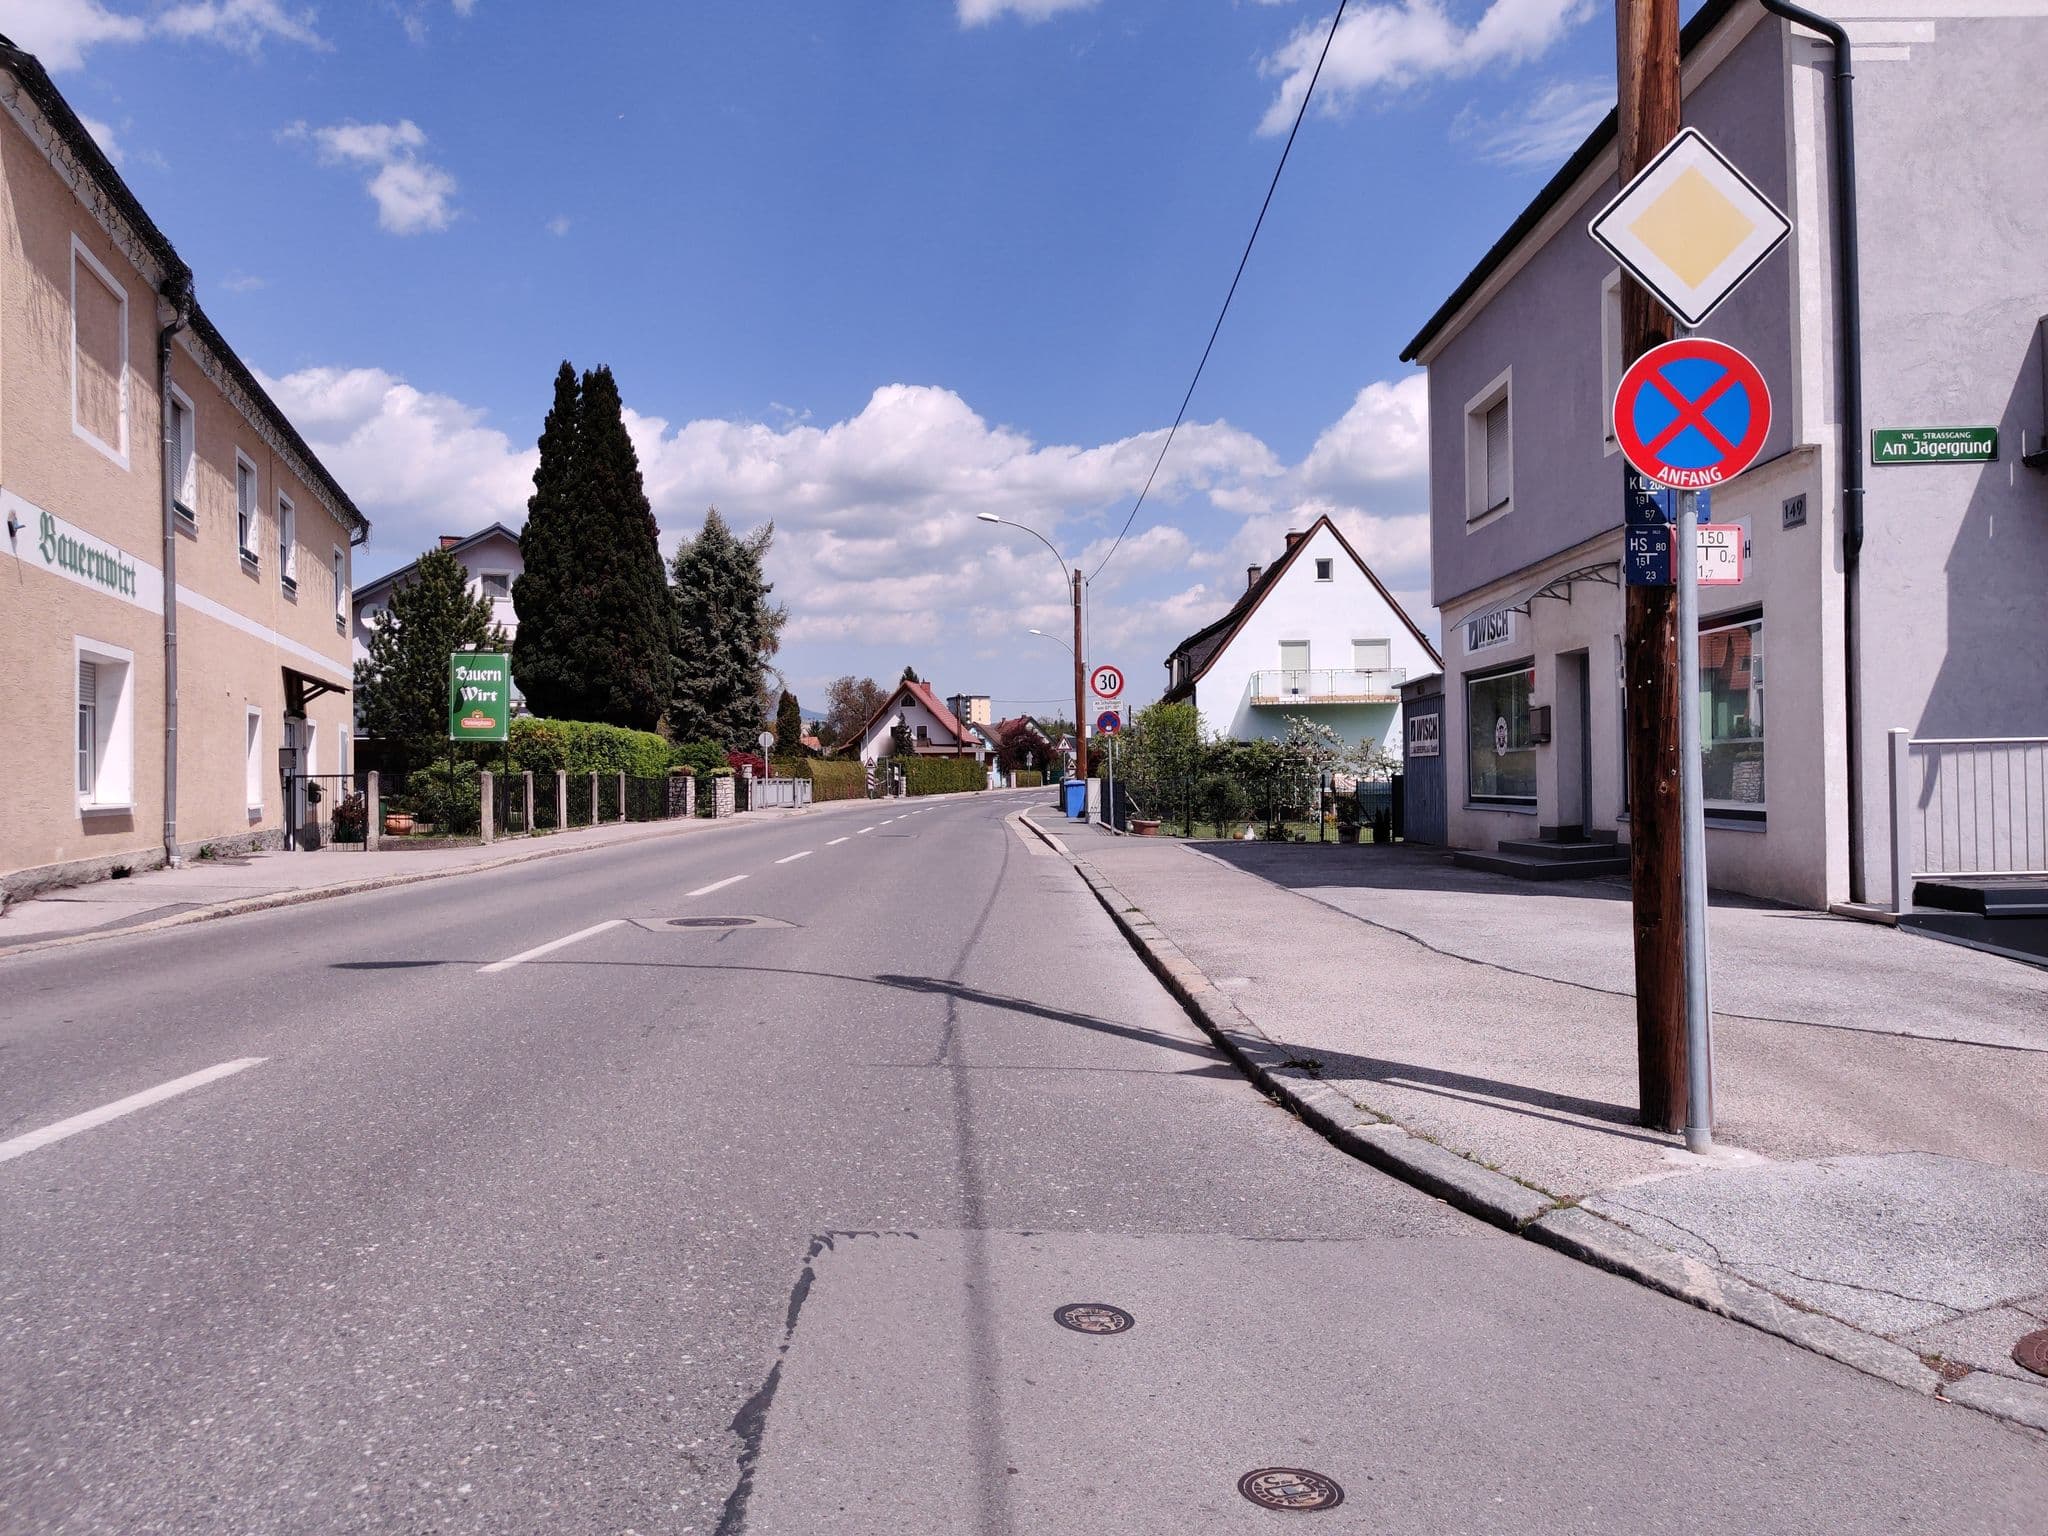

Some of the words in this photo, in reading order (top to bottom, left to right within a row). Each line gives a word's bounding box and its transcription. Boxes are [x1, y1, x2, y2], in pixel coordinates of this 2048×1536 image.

[1922, 431, 1971, 440] STRASSGANG
[1882, 441, 1907, 456] Am
[1911, 439, 1992, 457] Jägergrund
[1629, 476, 1647, 490] KL
[1656, 466, 1722, 485] ANFANG
[1630, 537, 1648, 551] HS
[1655, 542, 1667, 552] 80
[1699, 531, 1724, 545] 150
[38, 511, 136, 599] Bauernwirt
[1478, 609, 1509, 643] WISCH
[456, 666, 501, 681] Bauern
[1099, 674, 1116, 690] 30
[460, 687, 498, 701] Wirt
[1416, 716, 1438, 742] WISCH
